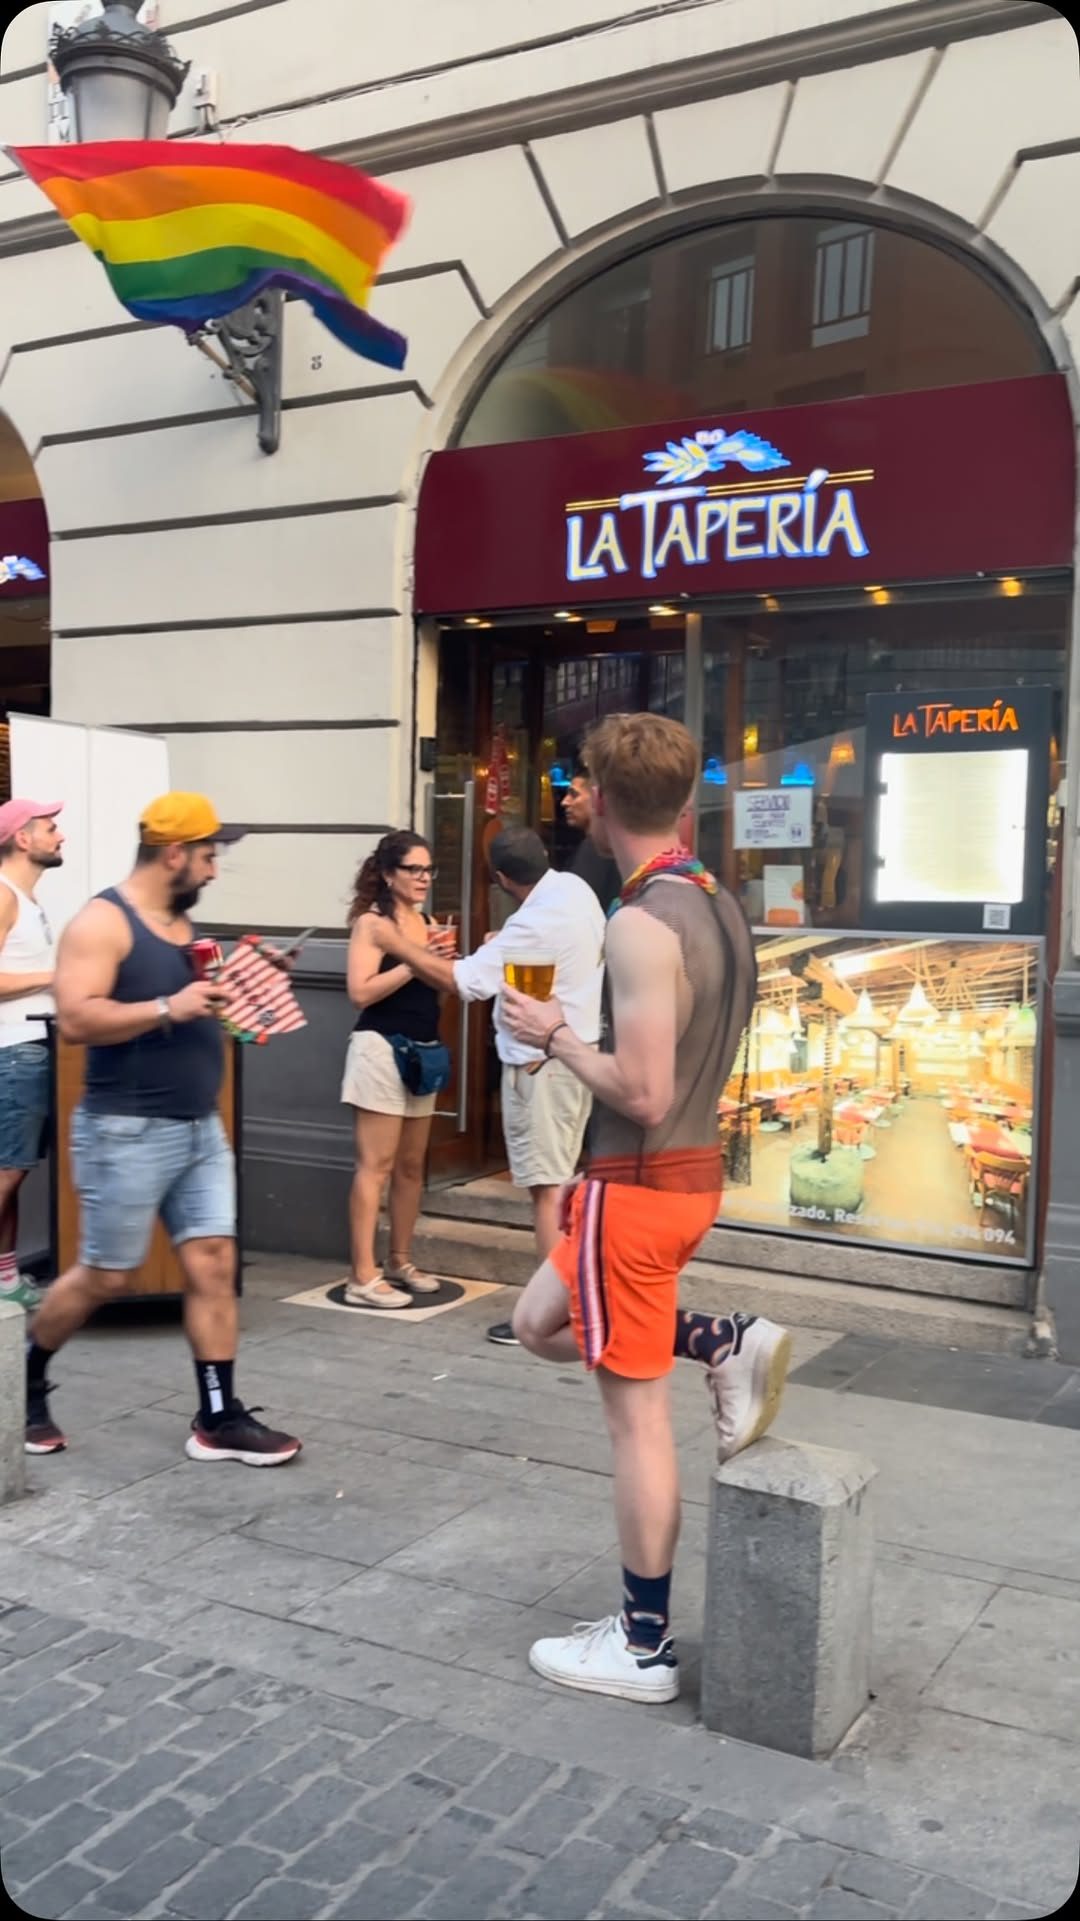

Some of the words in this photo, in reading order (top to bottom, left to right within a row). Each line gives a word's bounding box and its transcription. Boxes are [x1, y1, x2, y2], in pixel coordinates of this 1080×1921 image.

[566, 513, 629, 581] LA
[619, 468, 870, 578] TAPERÍA
[893, 711, 918, 737] LA
[917, 698, 1019, 738] TAPERÍA
[983, 1227, 1016, 1245] 094
